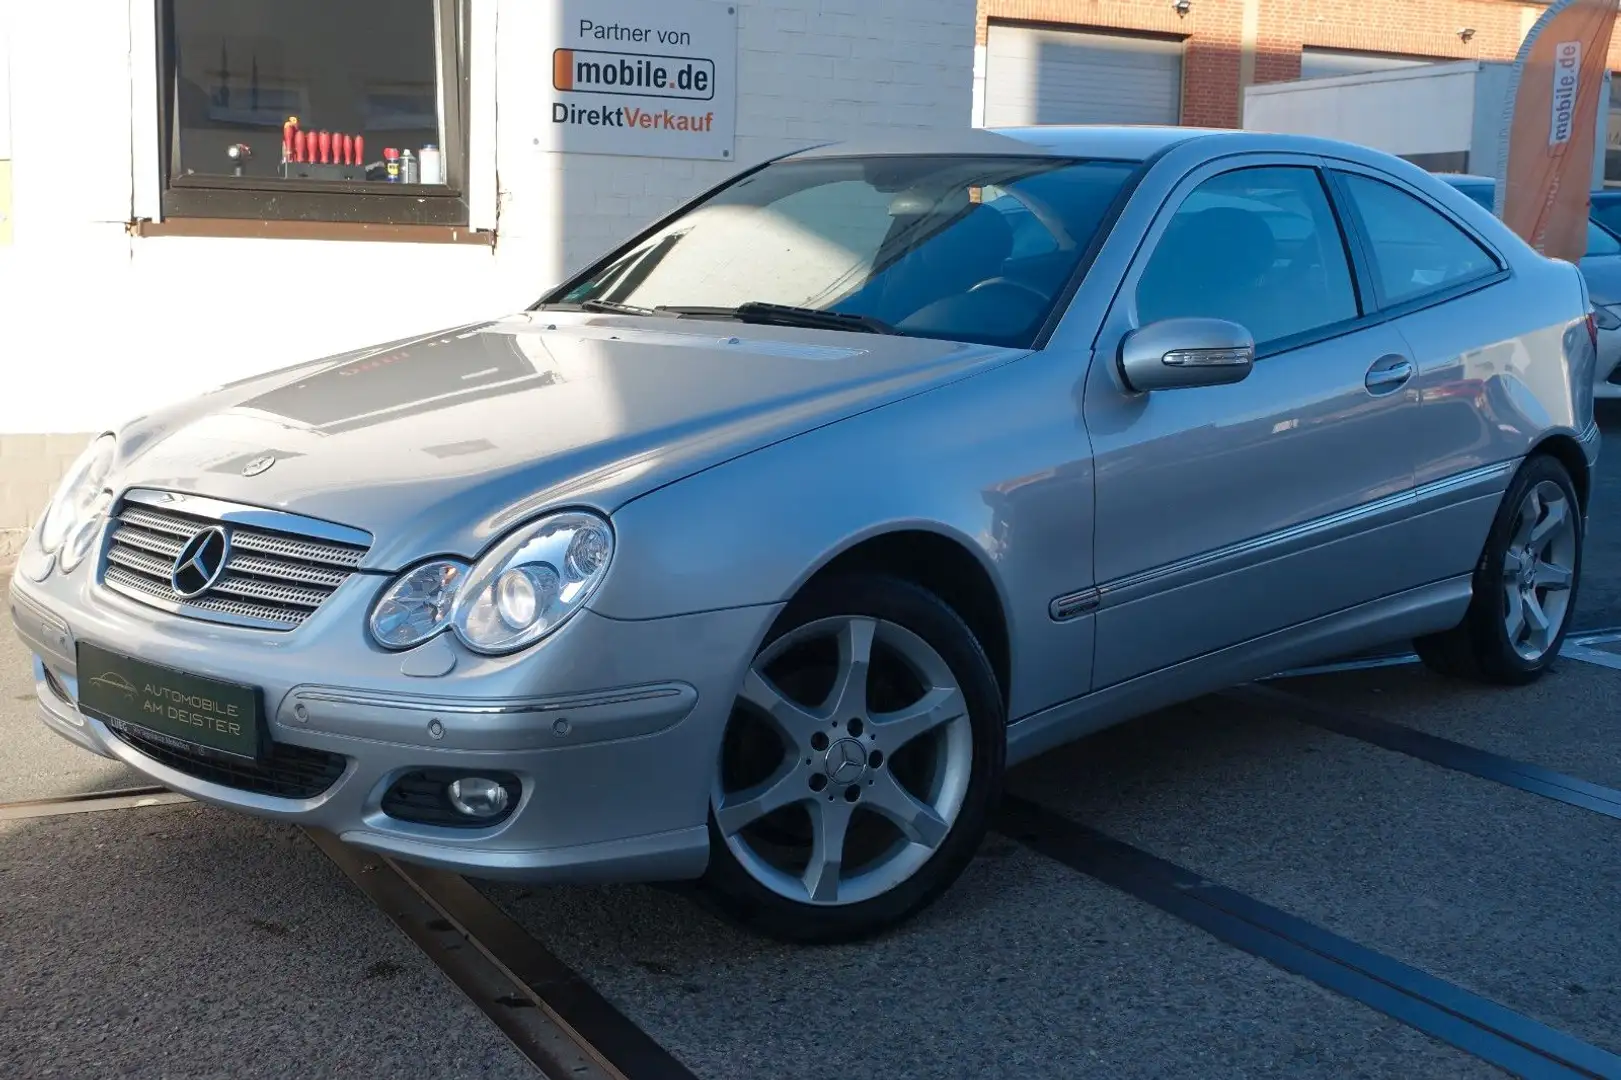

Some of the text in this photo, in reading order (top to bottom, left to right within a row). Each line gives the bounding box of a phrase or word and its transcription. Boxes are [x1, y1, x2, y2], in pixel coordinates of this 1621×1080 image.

[579, 19, 691, 46] Partner von
[576, 59, 708, 92] mobile.de
[1555, 44, 1576, 141] mobile.de
[552, 102, 714, 132] DirektVerkauf
[143, 683, 239, 717] AUTOMOBILE
[143, 699, 241, 736] AM DEISTER
